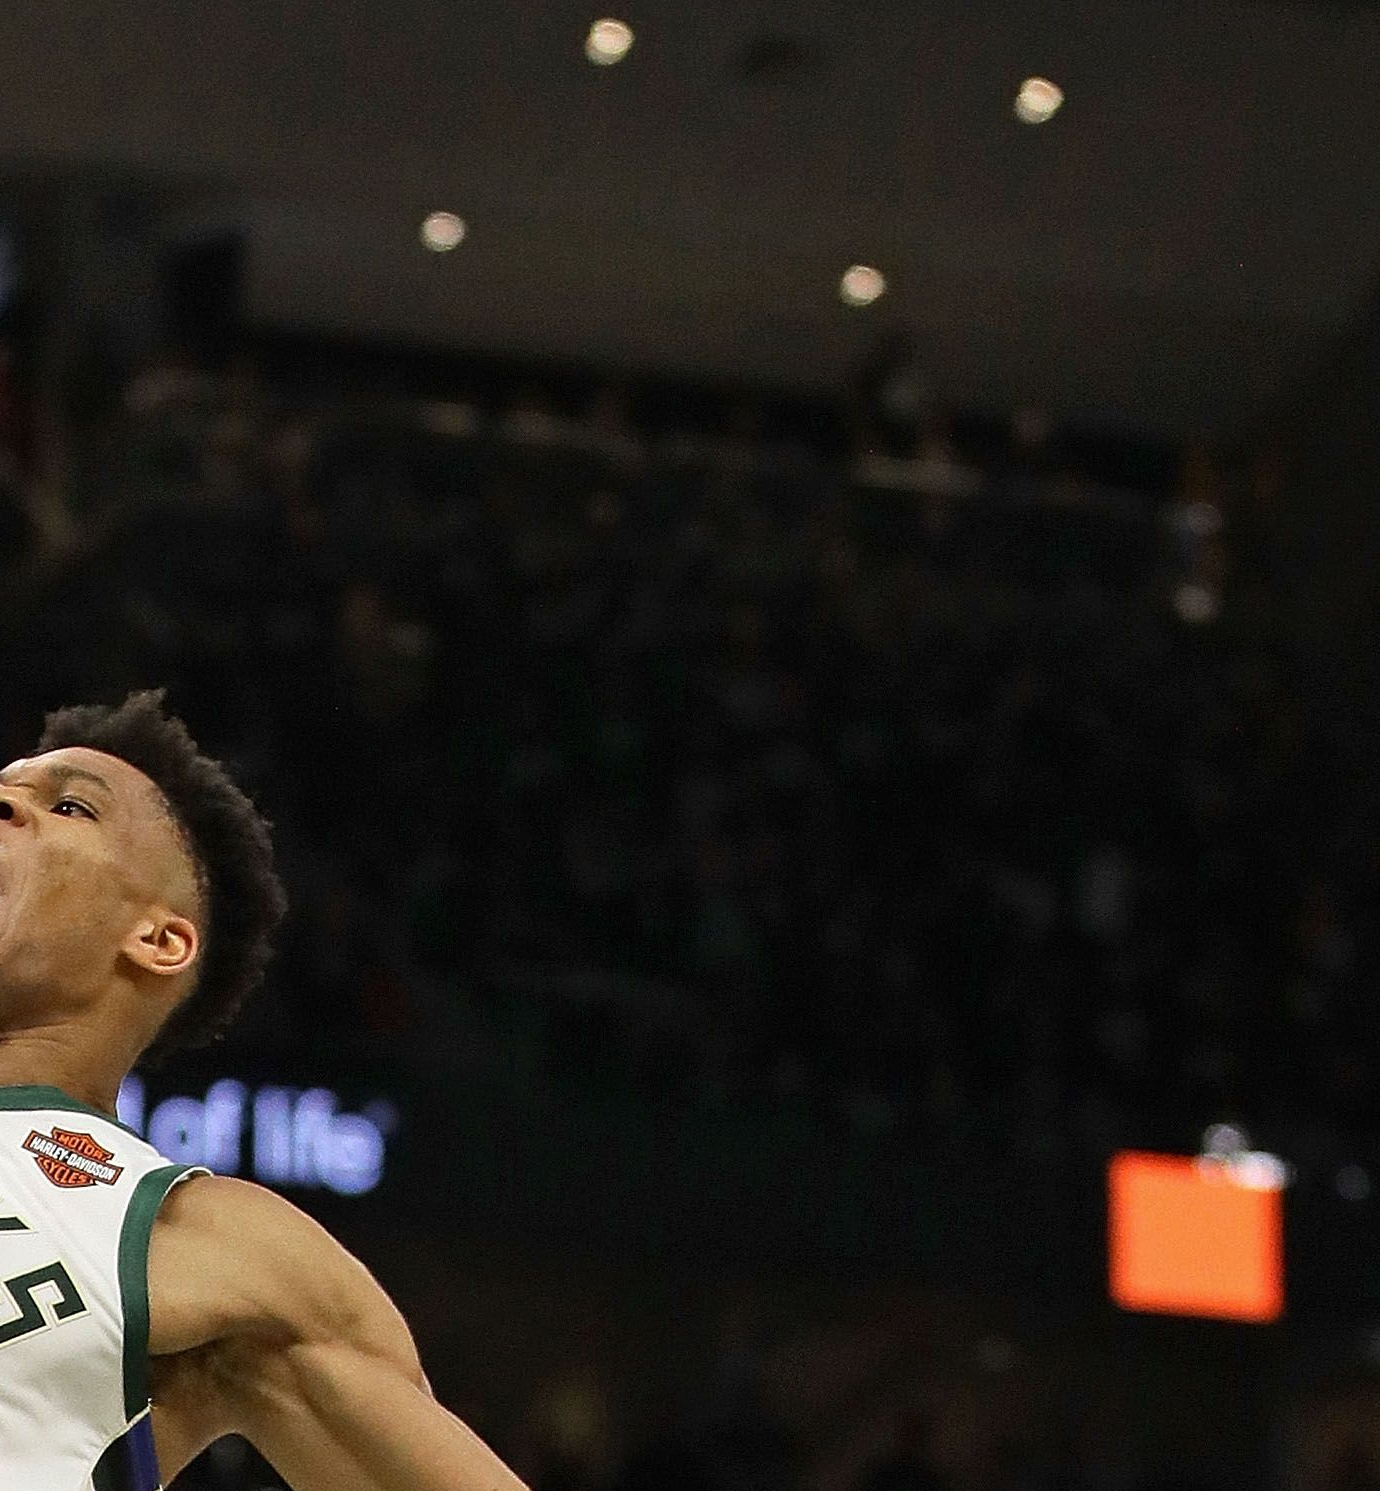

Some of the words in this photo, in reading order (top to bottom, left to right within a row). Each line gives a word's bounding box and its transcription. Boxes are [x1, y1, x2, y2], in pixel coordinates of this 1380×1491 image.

[30, 1136, 116, 1181] HARLEY-DAVIDSON
[58, 1133, 104, 1161] MOTOR
[42, 1159, 87, 1184] CYCLES
